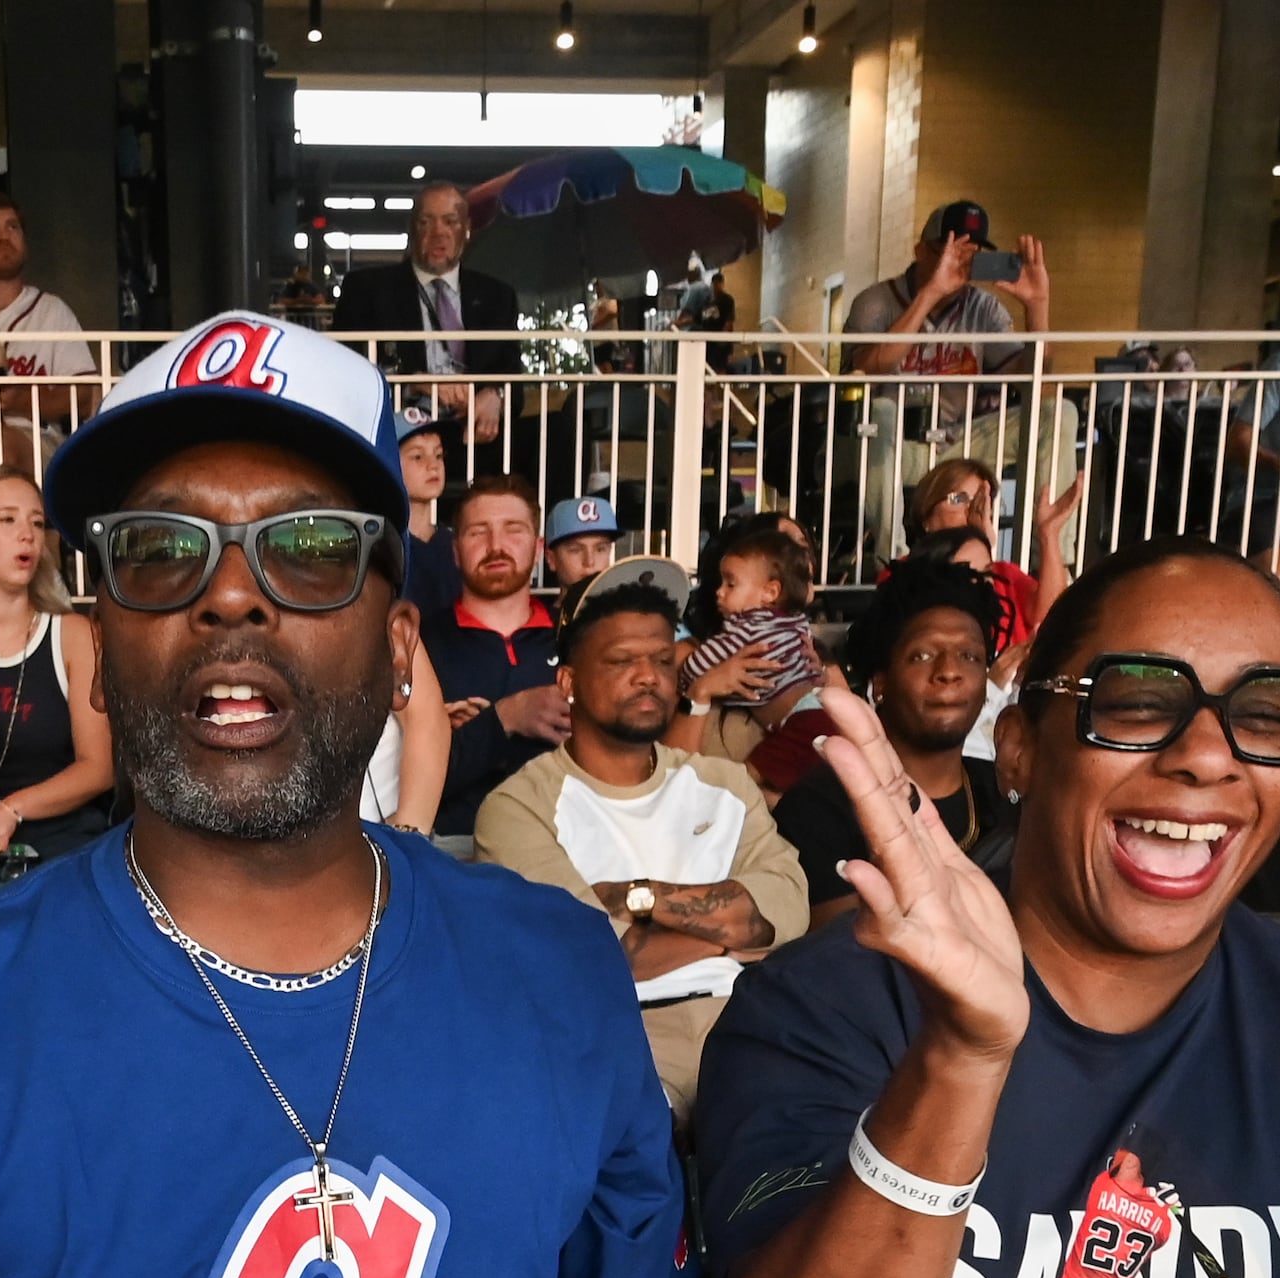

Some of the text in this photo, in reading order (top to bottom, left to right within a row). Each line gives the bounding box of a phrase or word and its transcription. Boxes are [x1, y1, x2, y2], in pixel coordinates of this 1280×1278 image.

[881, 1173, 940, 1207] Braves
[1097, 1190, 1153, 1227] HARRIS
[1081, 1218, 1154, 1278] 23
